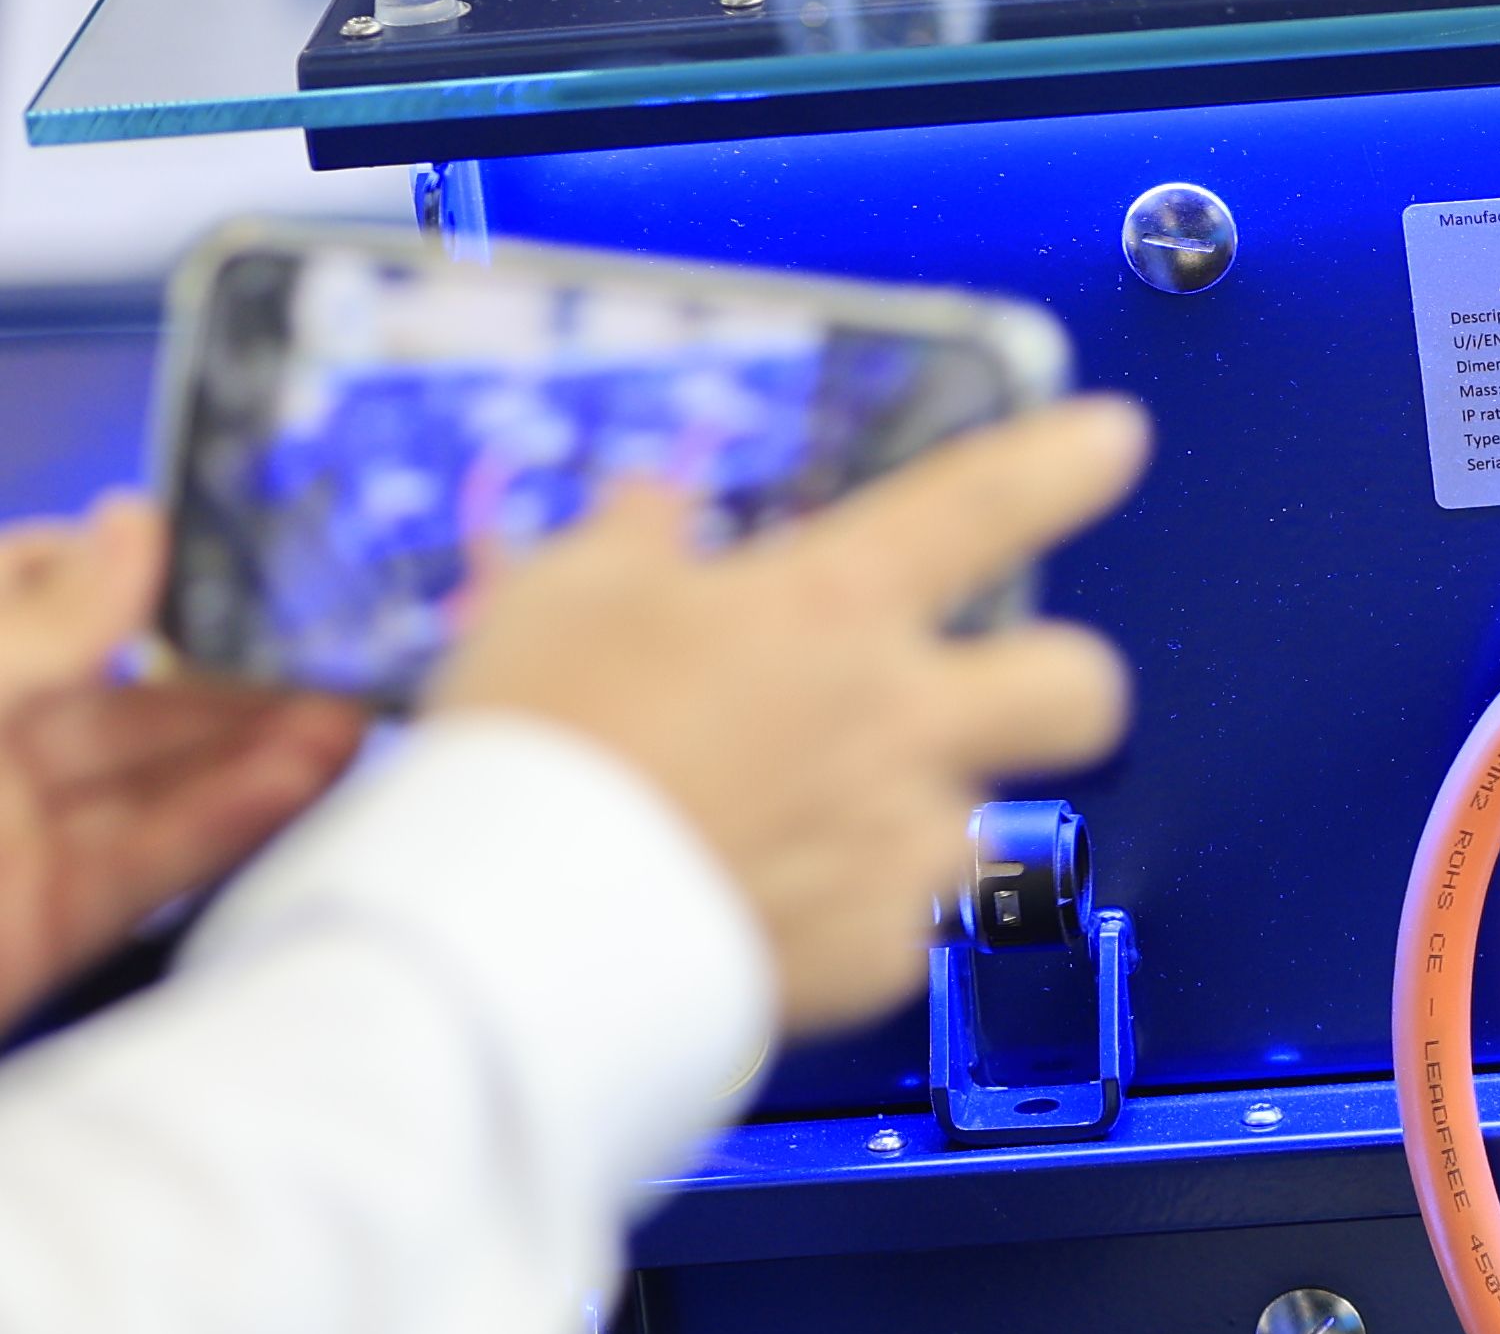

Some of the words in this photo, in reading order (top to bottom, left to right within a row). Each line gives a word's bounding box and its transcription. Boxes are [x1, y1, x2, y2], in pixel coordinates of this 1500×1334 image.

[1462, 409, 1476, 422] IP
[1464, 434, 1500, 449] Type
[1436, 830, 1474, 912] ROHS
[1426, 933, 1444, 974] CE
[1423, 1040, 1472, 1213] LEADFREE
